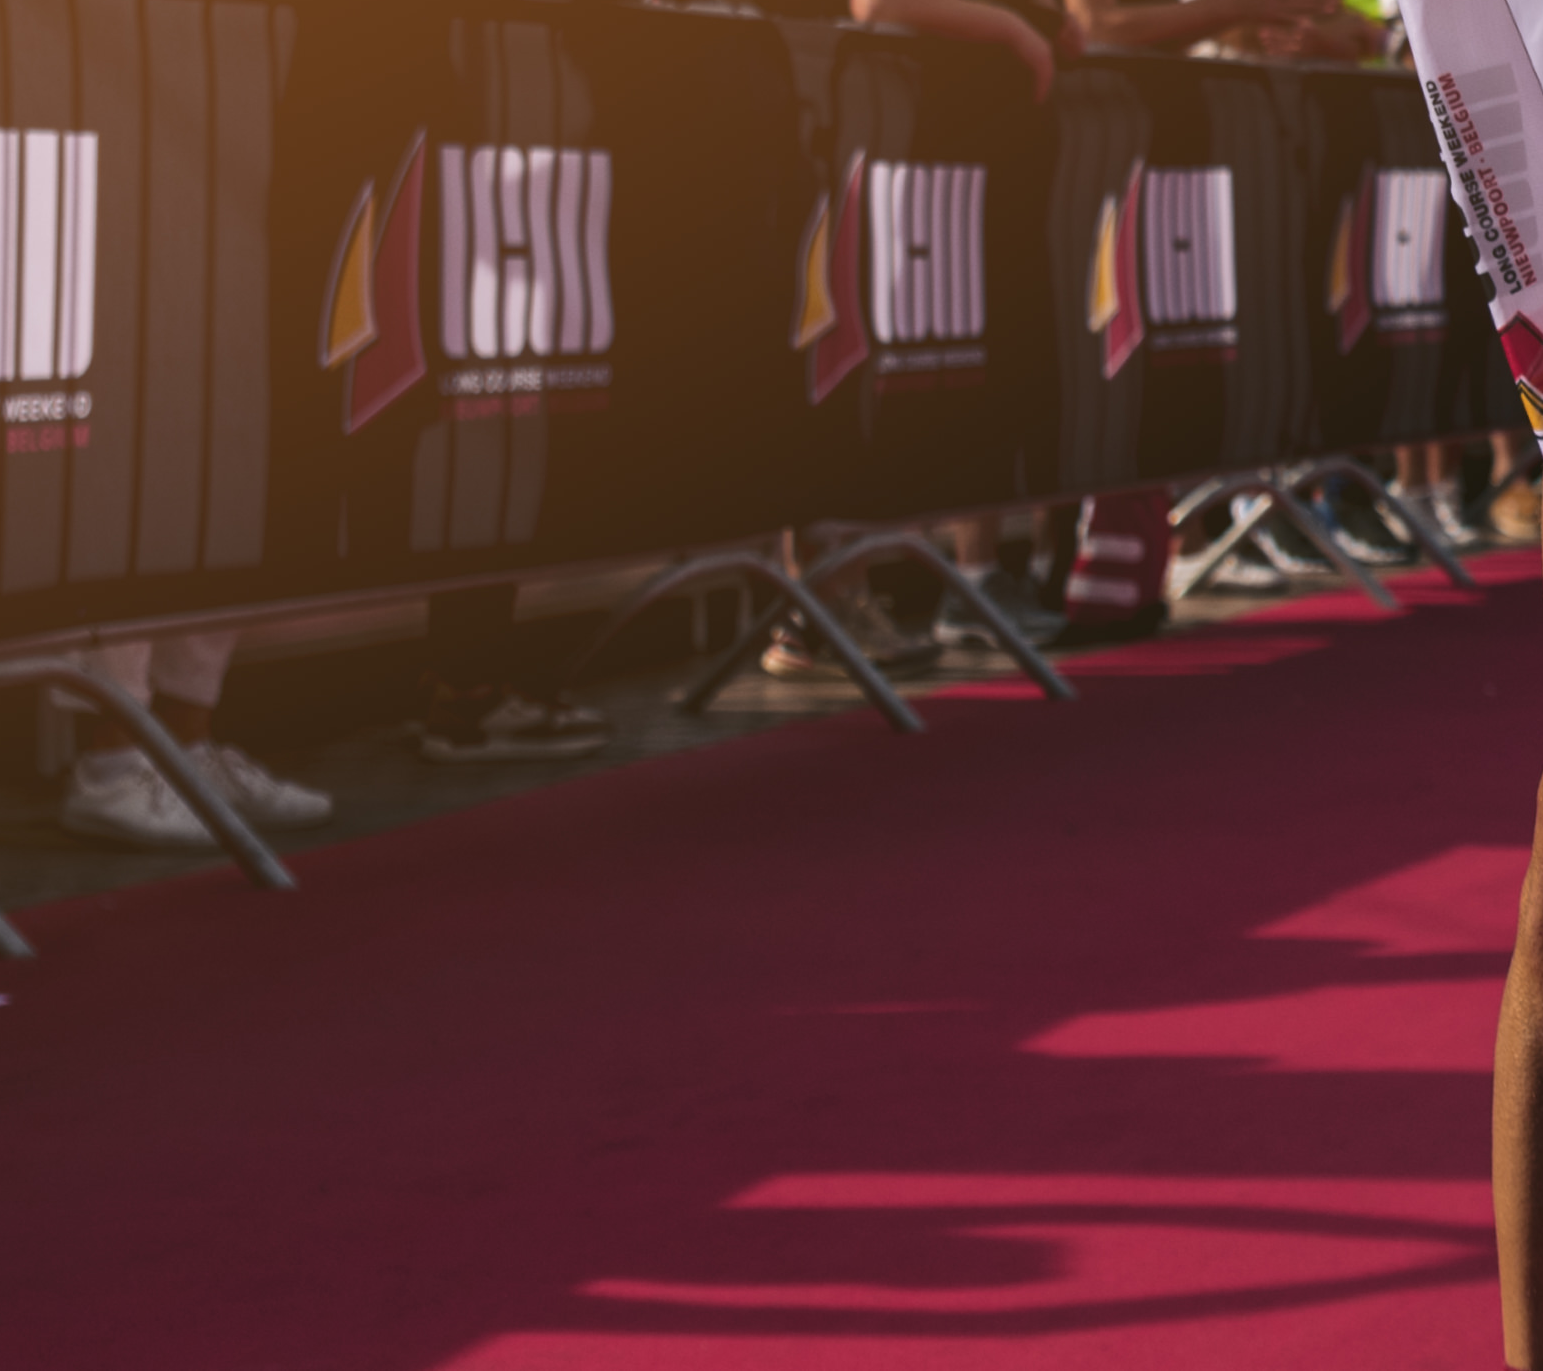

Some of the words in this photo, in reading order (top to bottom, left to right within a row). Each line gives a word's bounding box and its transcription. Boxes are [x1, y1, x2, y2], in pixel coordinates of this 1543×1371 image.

[1425, 80, 1469, 168] WEEKEND
[1437, 73, 1484, 156] BELGIUM
[1459, 170, 1500, 242] COURSE
[1477, 167, 1537, 287] NIEUWPOORT
[1492, 244, 1522, 296] LONG
